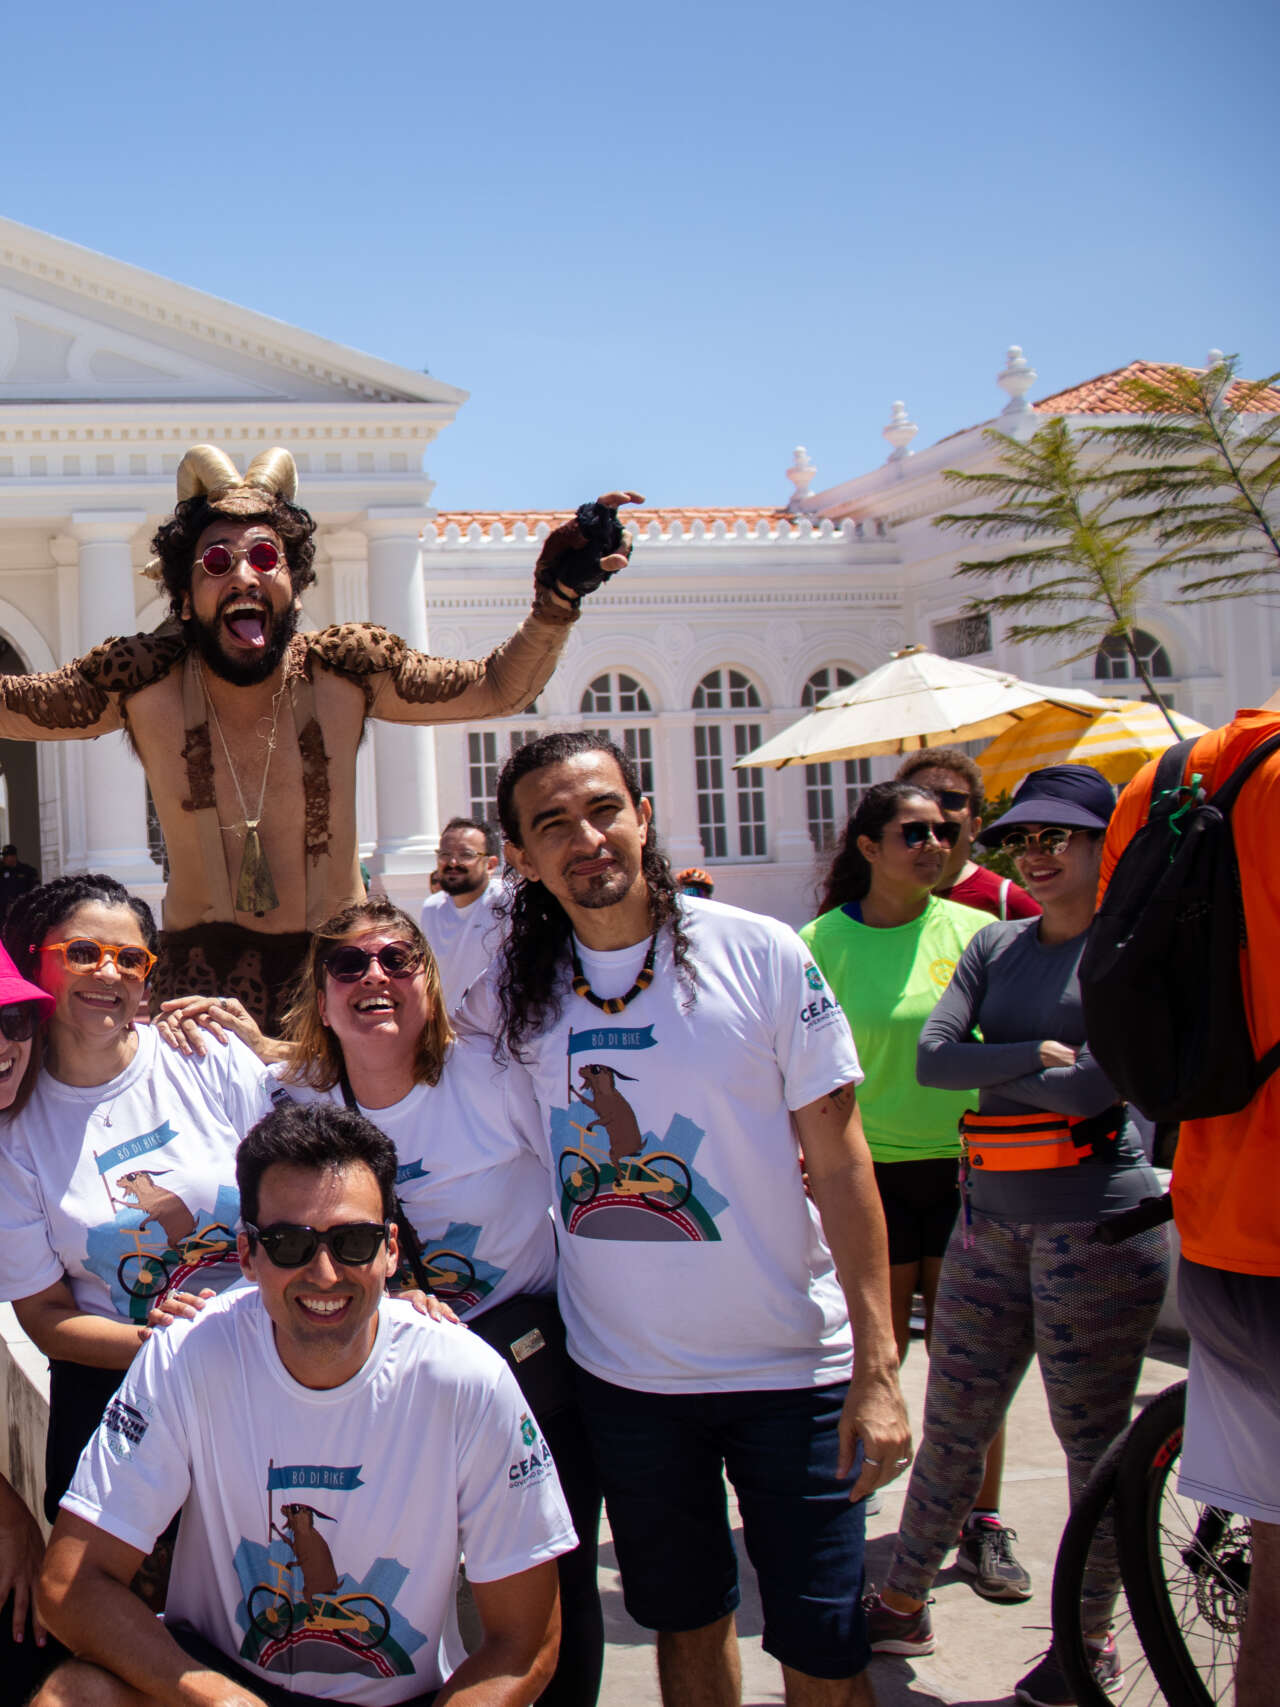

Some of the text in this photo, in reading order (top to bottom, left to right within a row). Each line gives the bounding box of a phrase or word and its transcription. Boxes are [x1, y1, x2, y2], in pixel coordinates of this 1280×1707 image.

[608, 1033, 619, 1046] DI
[622, 1032, 641, 1046] BIKE
[131, 1142, 142, 1154] DI
[310, 1471, 320, 1485] DI
[323, 1471, 344, 1485] BIKE
